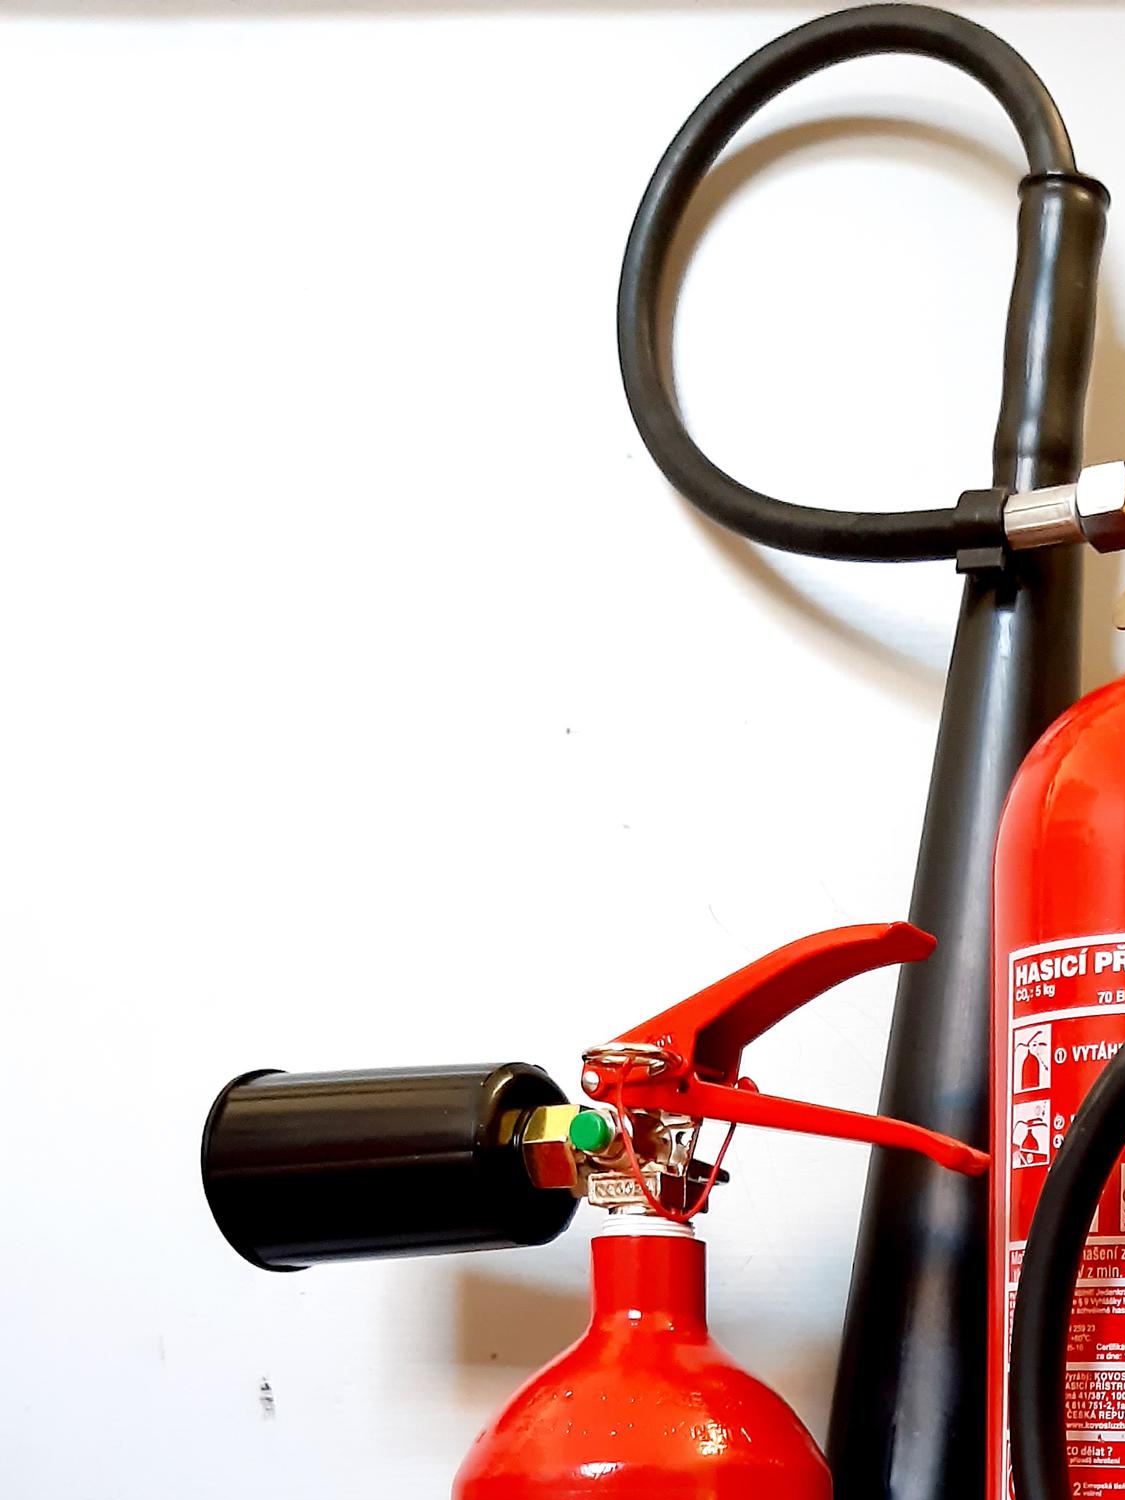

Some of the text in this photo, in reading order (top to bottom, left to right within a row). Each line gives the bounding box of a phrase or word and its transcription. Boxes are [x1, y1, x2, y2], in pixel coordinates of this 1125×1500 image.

[1015, 948, 1087, 987] HASICÍ
[1043, 983, 1055, 998] kg
[1097, 990, 1125, 1004] 70 B
